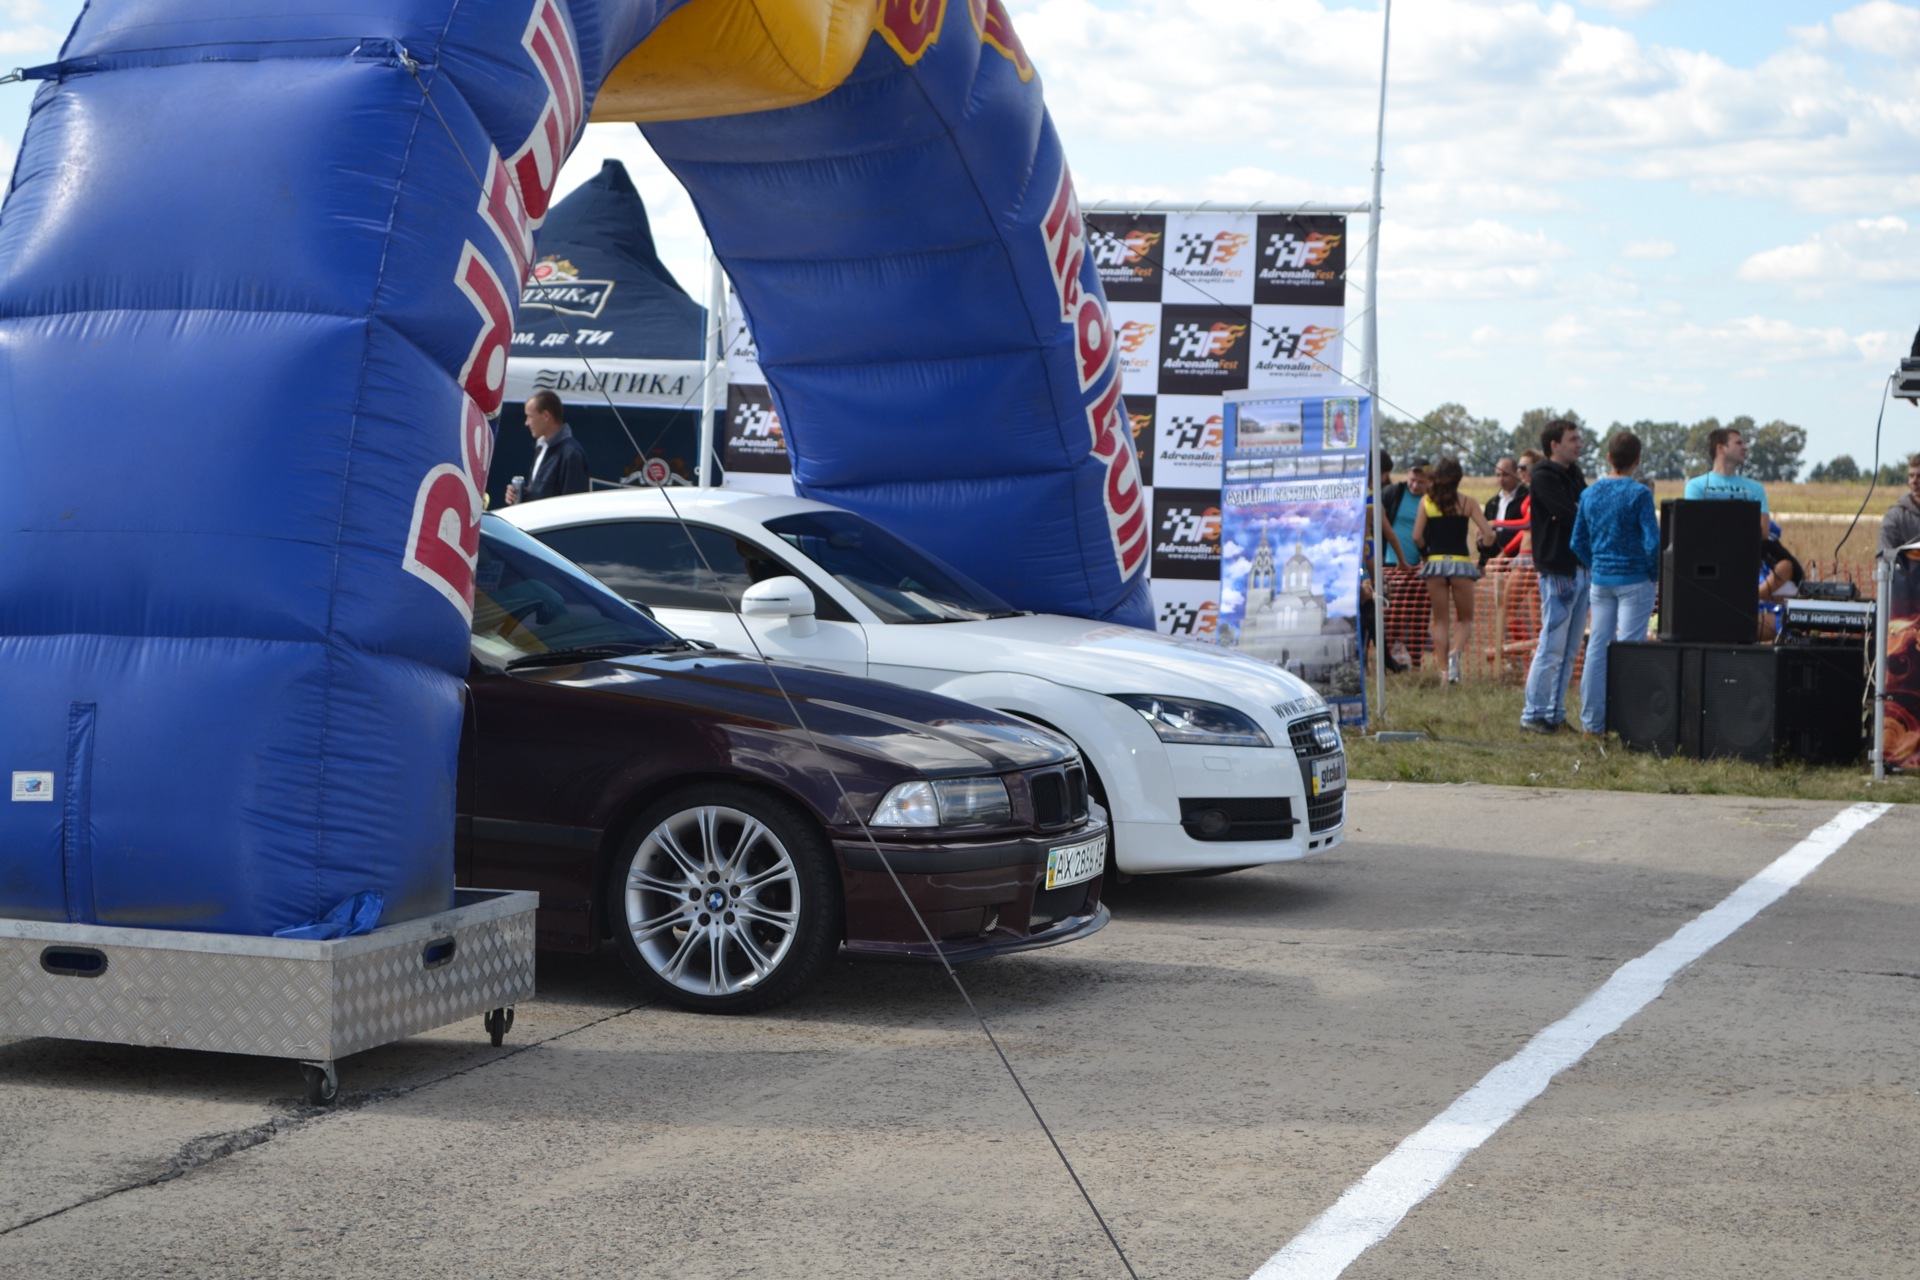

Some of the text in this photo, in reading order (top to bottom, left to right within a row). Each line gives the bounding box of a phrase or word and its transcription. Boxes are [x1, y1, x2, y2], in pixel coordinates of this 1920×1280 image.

[1169, 267, 1243, 277] AdrenalinFest
[1259, 267, 1335, 279] AdrenalinFest
[522, 287, 600, 305] ЛТИКА
[540, 333, 569, 347] ДЕ
[575, 329, 614, 345] ТИ
[1163, 357, 1239, 369] AdrenalinFest
[1255, 361, 1330, 371] AdrenalinFest
[556, 370, 687, 396] БАЛТИКА
